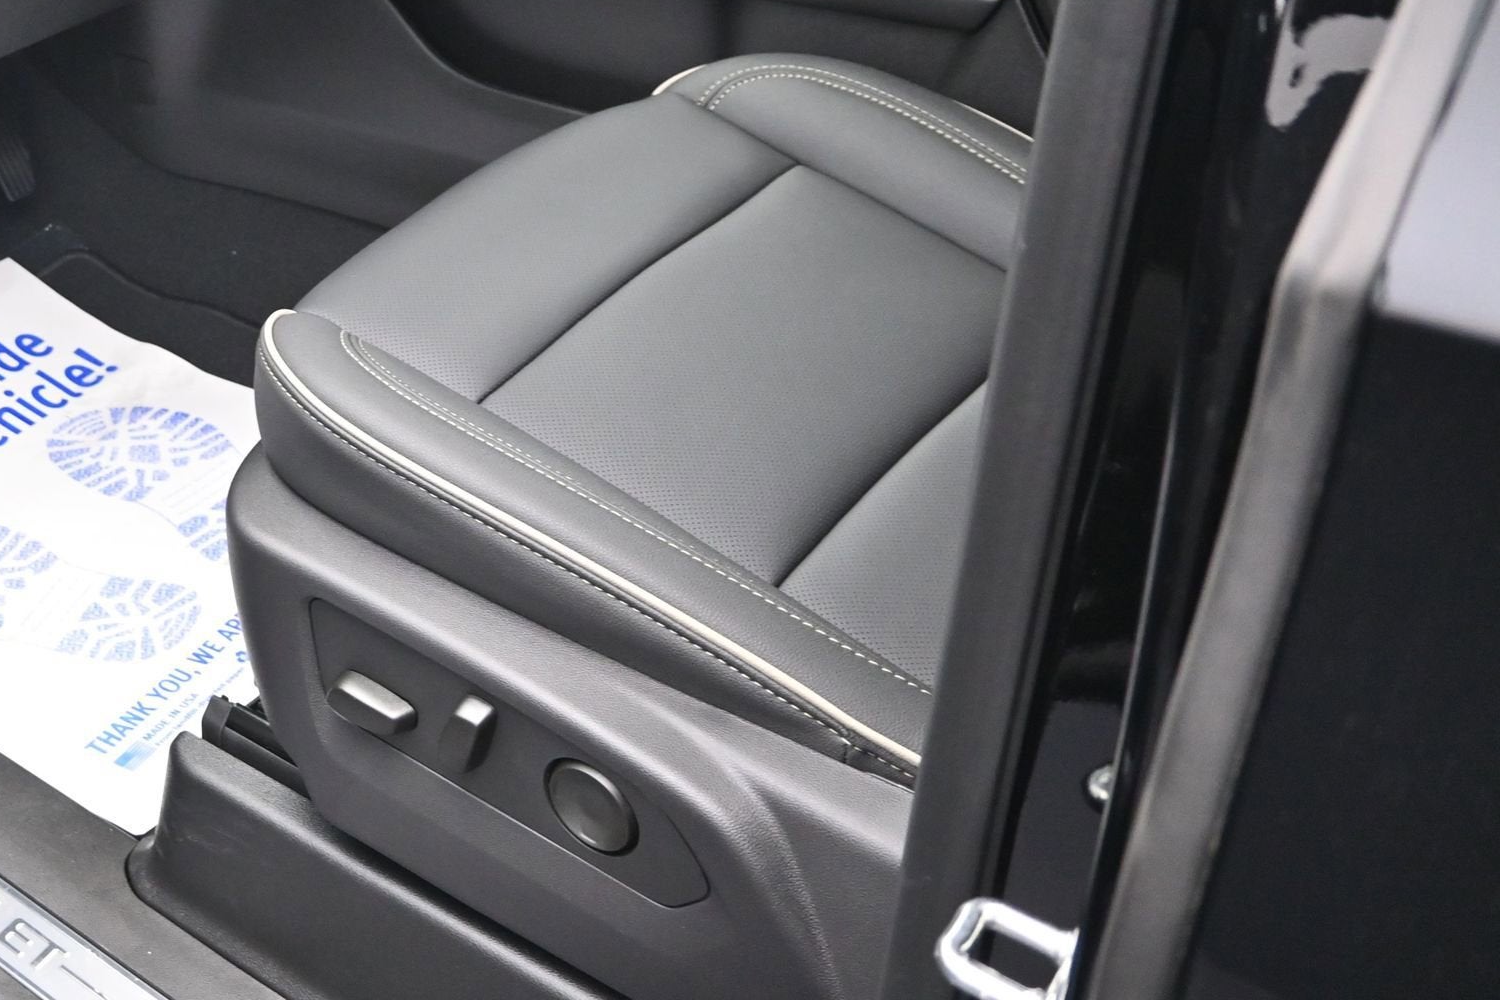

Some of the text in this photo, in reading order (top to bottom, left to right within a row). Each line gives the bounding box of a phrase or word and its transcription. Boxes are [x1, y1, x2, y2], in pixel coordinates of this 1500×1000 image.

[84, 700, 157, 754] THANK
[145, 667, 202, 701] YOU,
[186, 640, 225, 665] WE
[143, 693, 200, 741] MADE IN USA
